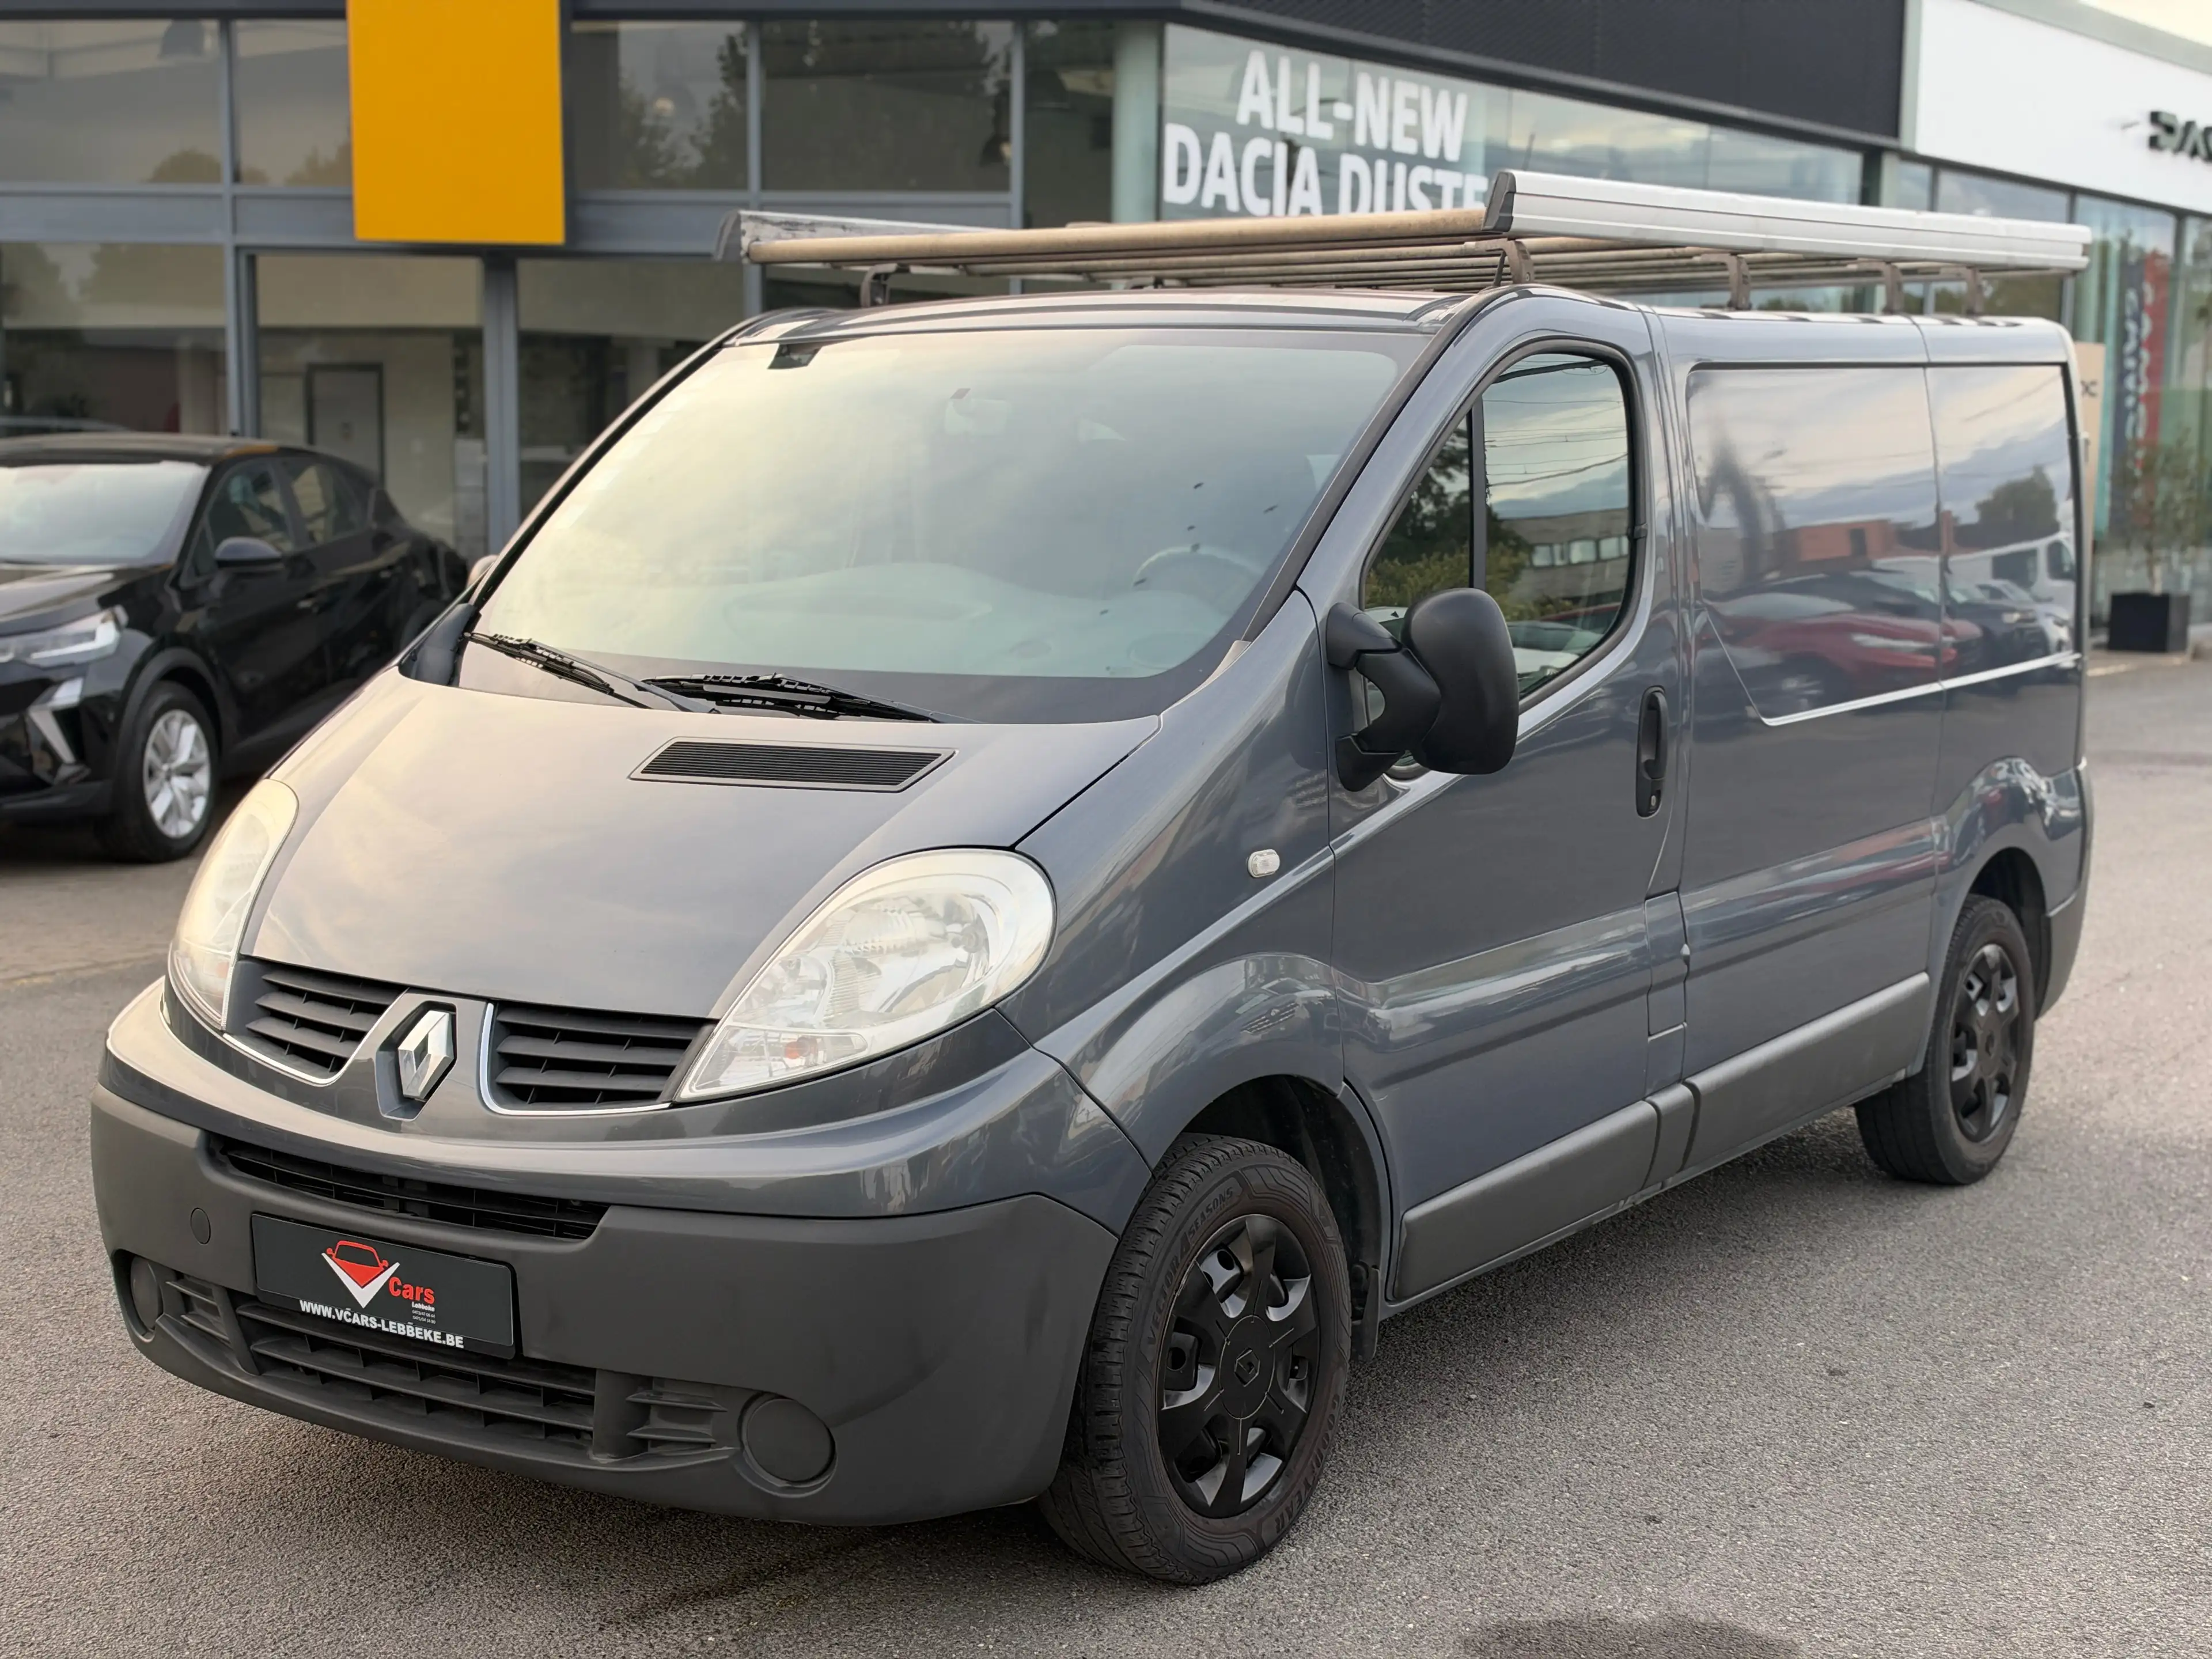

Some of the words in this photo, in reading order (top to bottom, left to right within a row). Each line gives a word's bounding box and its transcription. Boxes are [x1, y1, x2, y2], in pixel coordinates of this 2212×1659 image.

[1236, 50, 1467, 162] ALL-NEW
[1163, 123, 1323, 217] DACIA
[1338, 153, 1488, 215] DUSTE
[299, 1300, 464, 1349] WWW.VCARS-LEBBEKE.BE
[388, 1277, 435, 1305] Cars
[411, 1301, 435, 1312] Lebbeke
[1147, 1254, 1181, 1346] VECTOR
